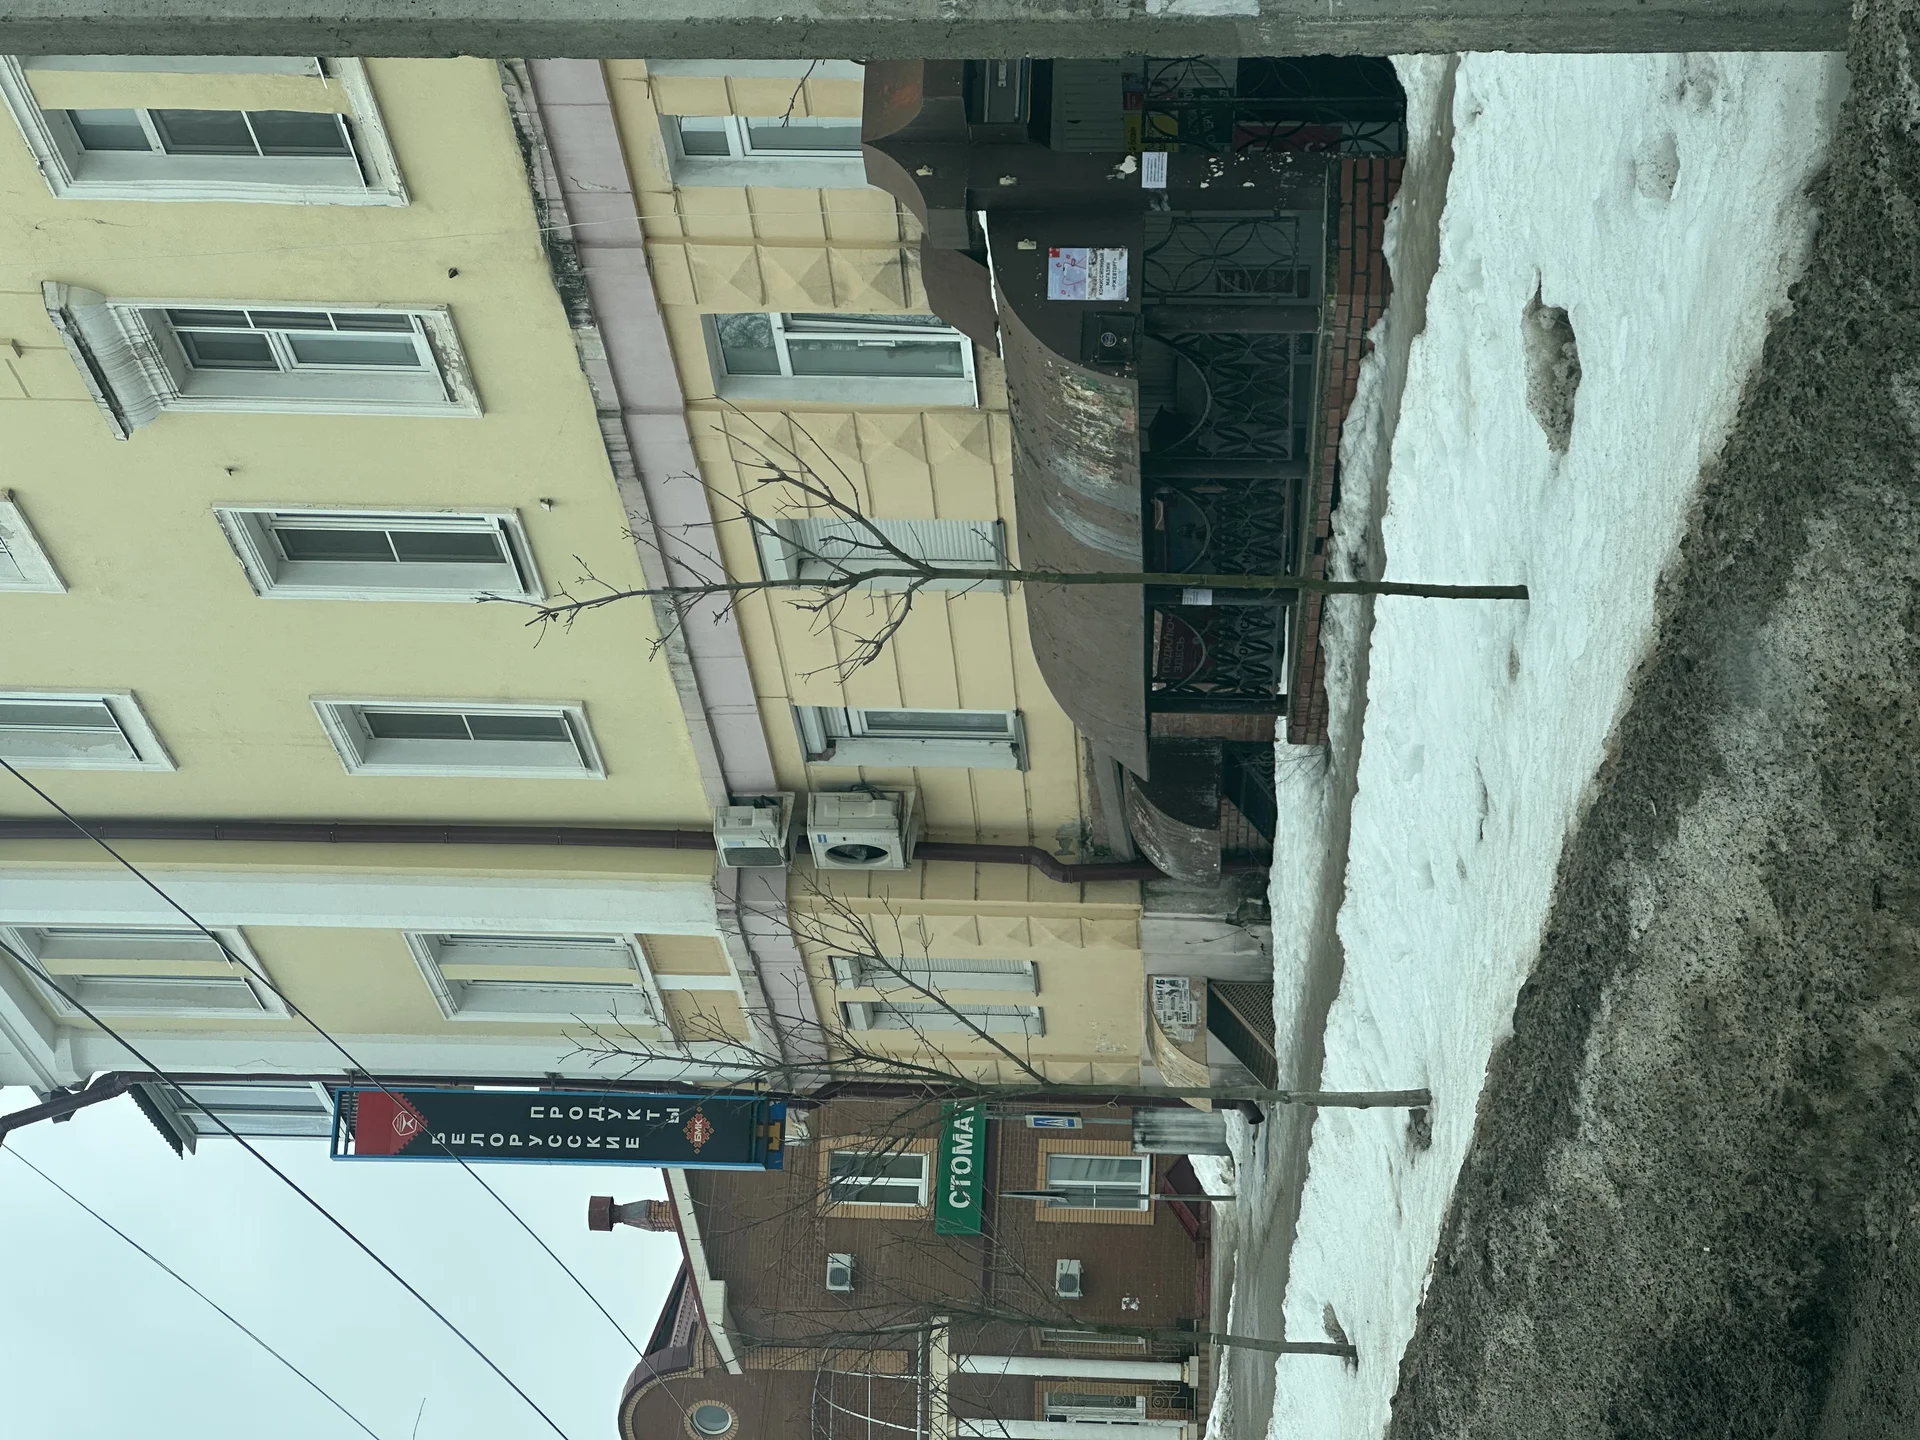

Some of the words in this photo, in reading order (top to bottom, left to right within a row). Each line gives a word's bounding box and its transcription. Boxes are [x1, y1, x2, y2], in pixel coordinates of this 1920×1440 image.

[1174, 636, 1186, 673] ЗДЕСЬ
[530, 1106, 680, 1124] ПРОДУКТЫ
[431, 1132, 640, 1150] БЕЛОРУССКИЕ
[694, 1120, 702, 1142] БМК
